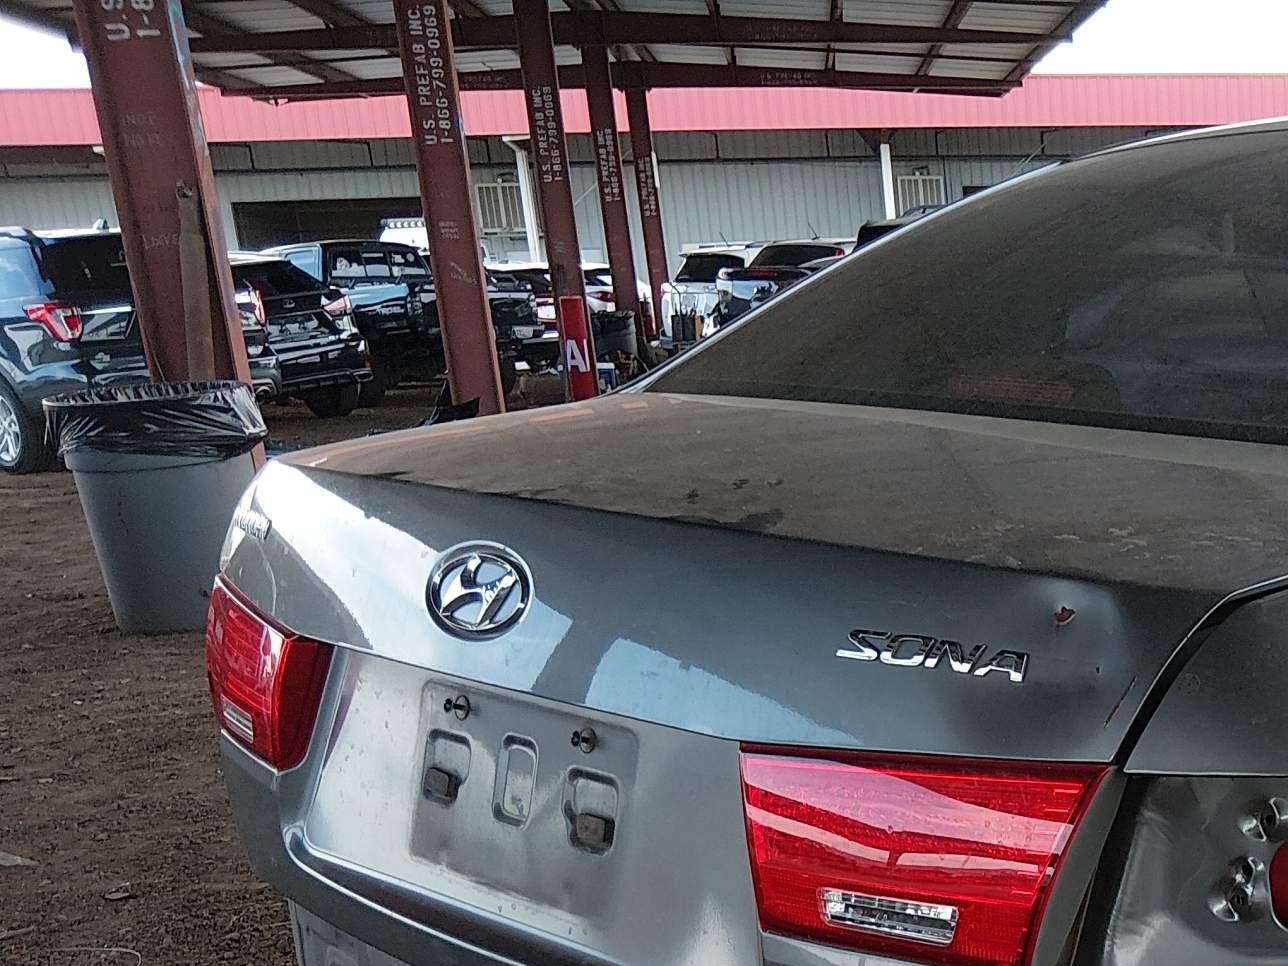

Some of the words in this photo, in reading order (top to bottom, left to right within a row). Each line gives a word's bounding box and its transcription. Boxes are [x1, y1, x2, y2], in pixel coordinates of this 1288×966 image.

[407, 4, 424, 35] INC.
[412, 43, 433, 106] PREFAB
[423, 5, 454, 143] 1-866-799-0969
[532, 85, 543, 107] INC.
[423, 114, 438, 145] U.S.
[535, 112, 549, 155] PREFAB
[543, 86, 563, 181] 1-866-799-0969
[541, 161, 553, 183] U.S.
[835, 628, 1029, 683] SONA
